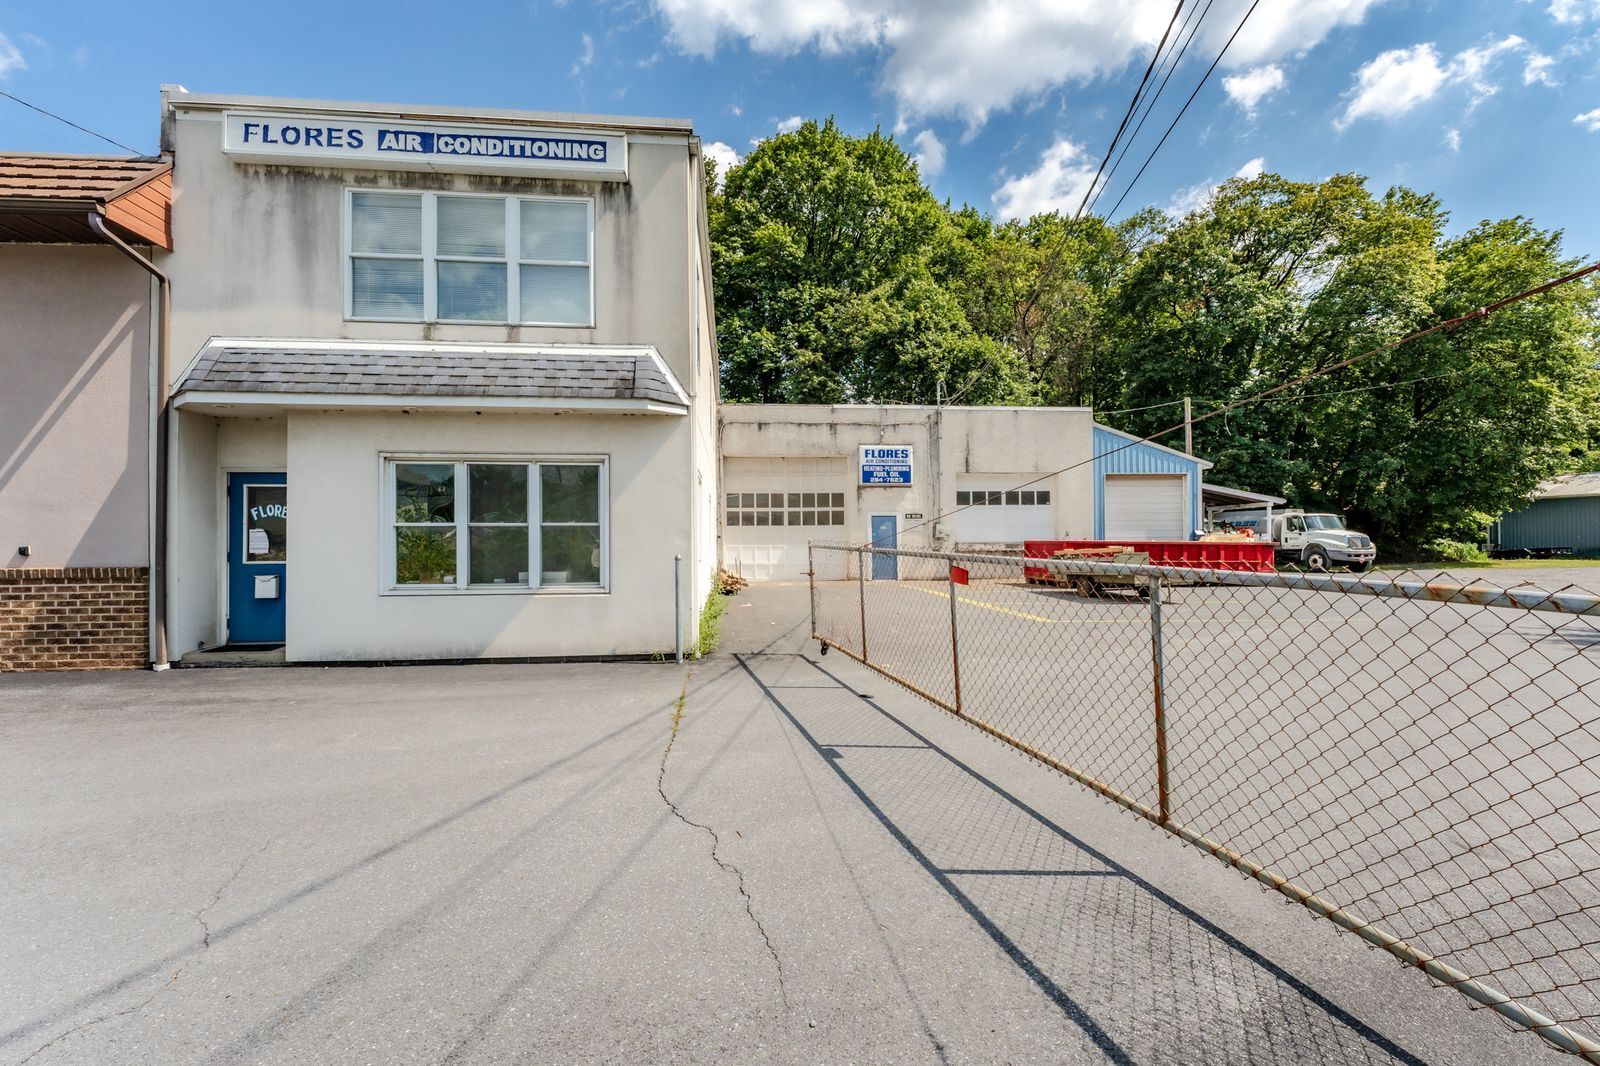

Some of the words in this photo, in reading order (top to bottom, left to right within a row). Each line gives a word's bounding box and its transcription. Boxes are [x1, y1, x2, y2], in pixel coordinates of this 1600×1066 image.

[243, 123, 364, 149] FLORES
[380, 132, 423, 151] AIR
[438, 136, 605, 160] CONDITIONING
[865, 449, 909, 458] FLORES
